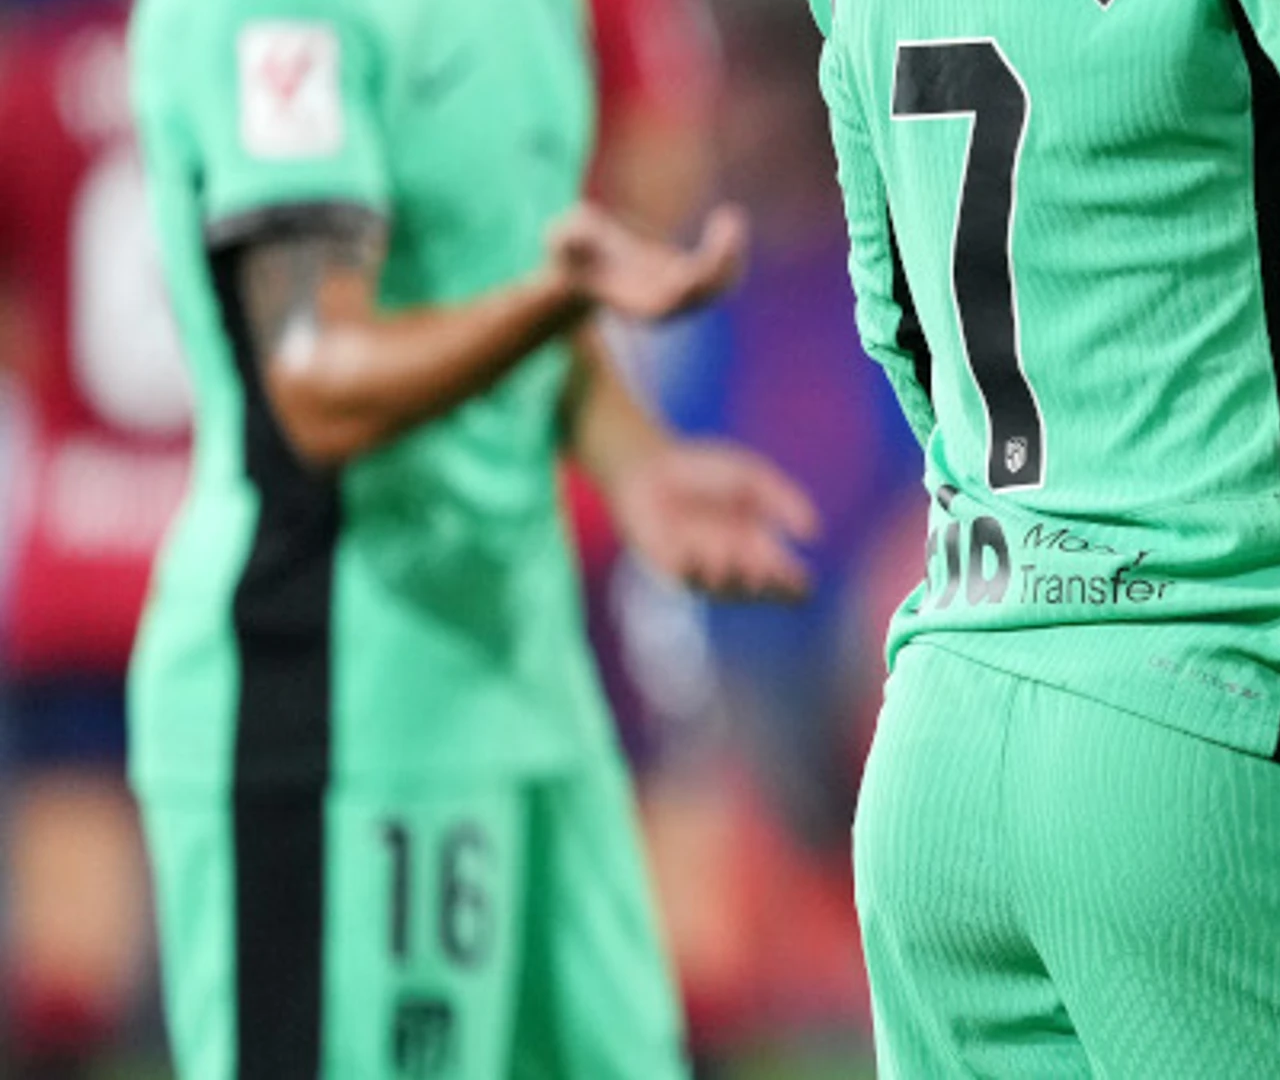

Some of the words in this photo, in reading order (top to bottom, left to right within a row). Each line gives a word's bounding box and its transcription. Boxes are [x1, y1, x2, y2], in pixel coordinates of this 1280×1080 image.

[889, 36, 1047, 493] 7
[1020, 564, 1175, 605] Transfer
[374, 815, 497, 975] 16
